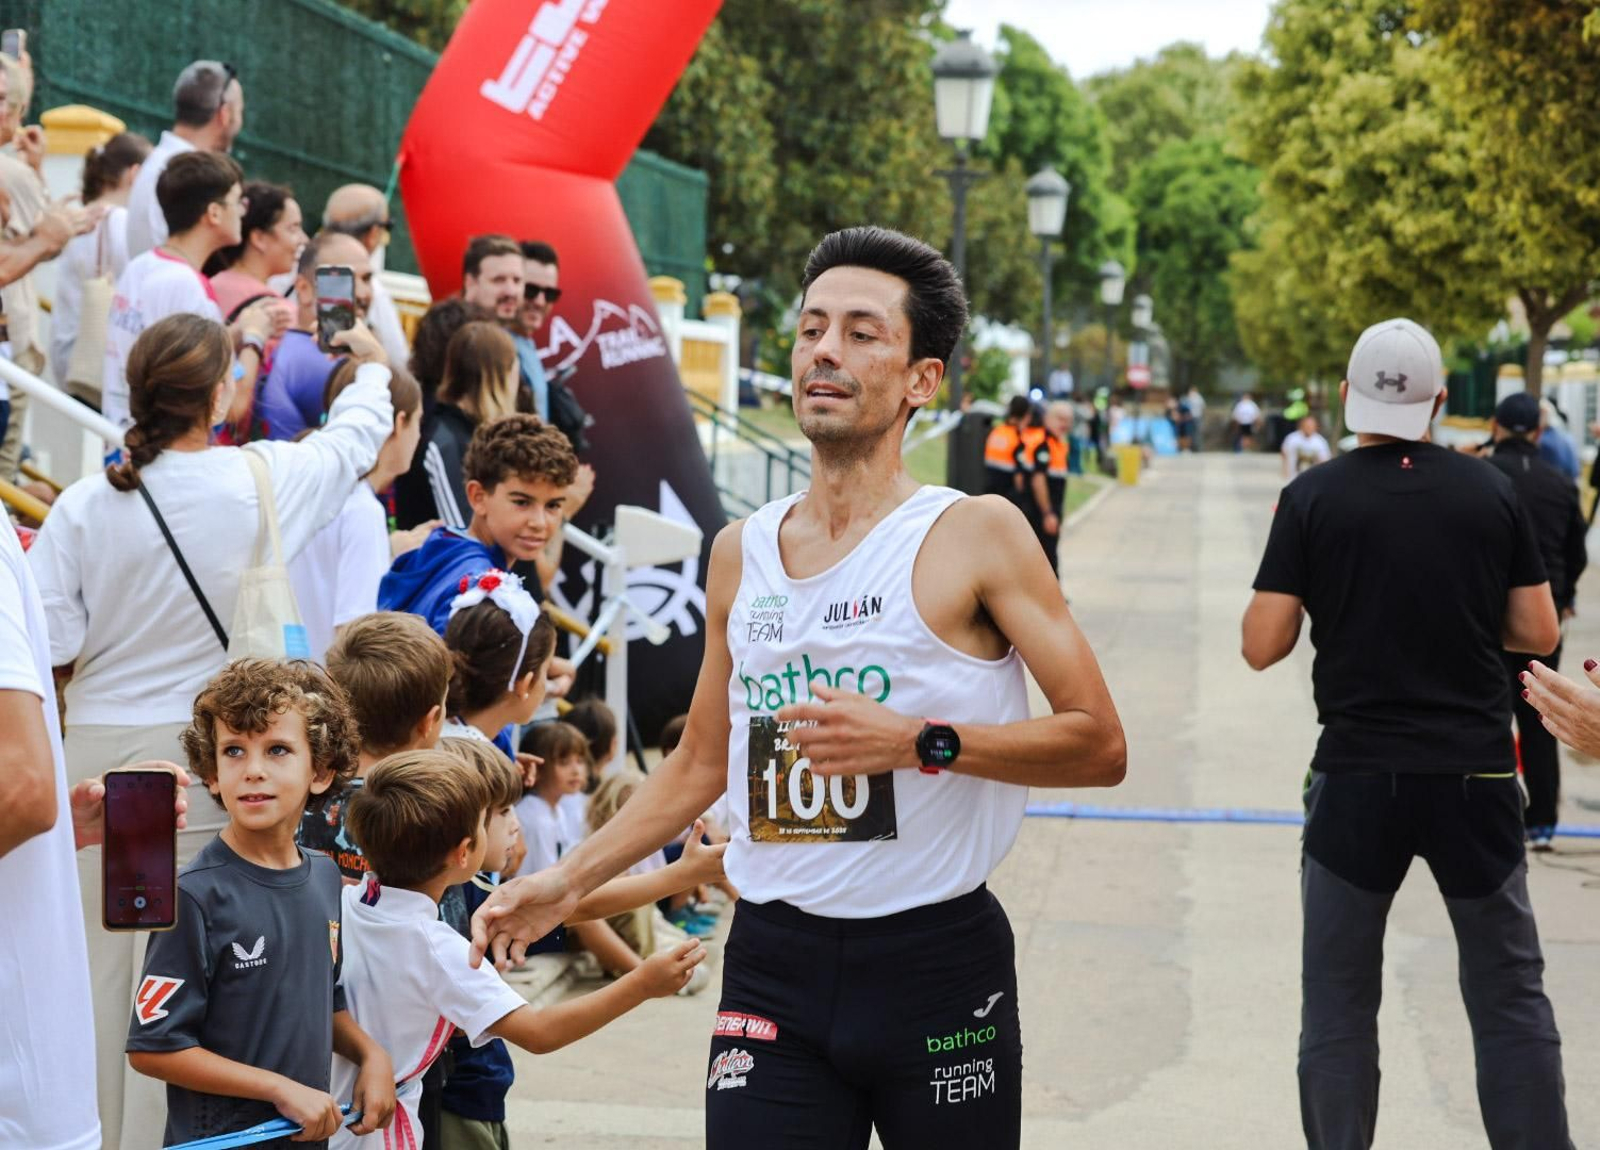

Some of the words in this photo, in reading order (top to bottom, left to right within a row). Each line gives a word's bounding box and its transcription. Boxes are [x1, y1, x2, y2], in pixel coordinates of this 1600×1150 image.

[527, 25, 589, 121] ACTIVE
[750, 609, 784, 624] running
[823, 594, 883, 624] JULIÁN
[746, 621, 784, 644] TEAM
[762, 756, 870, 820] 100
[926, 1025, 996, 1053] bathco
[934, 1058, 993, 1080] running
[930, 1070, 995, 1105] TEAM
